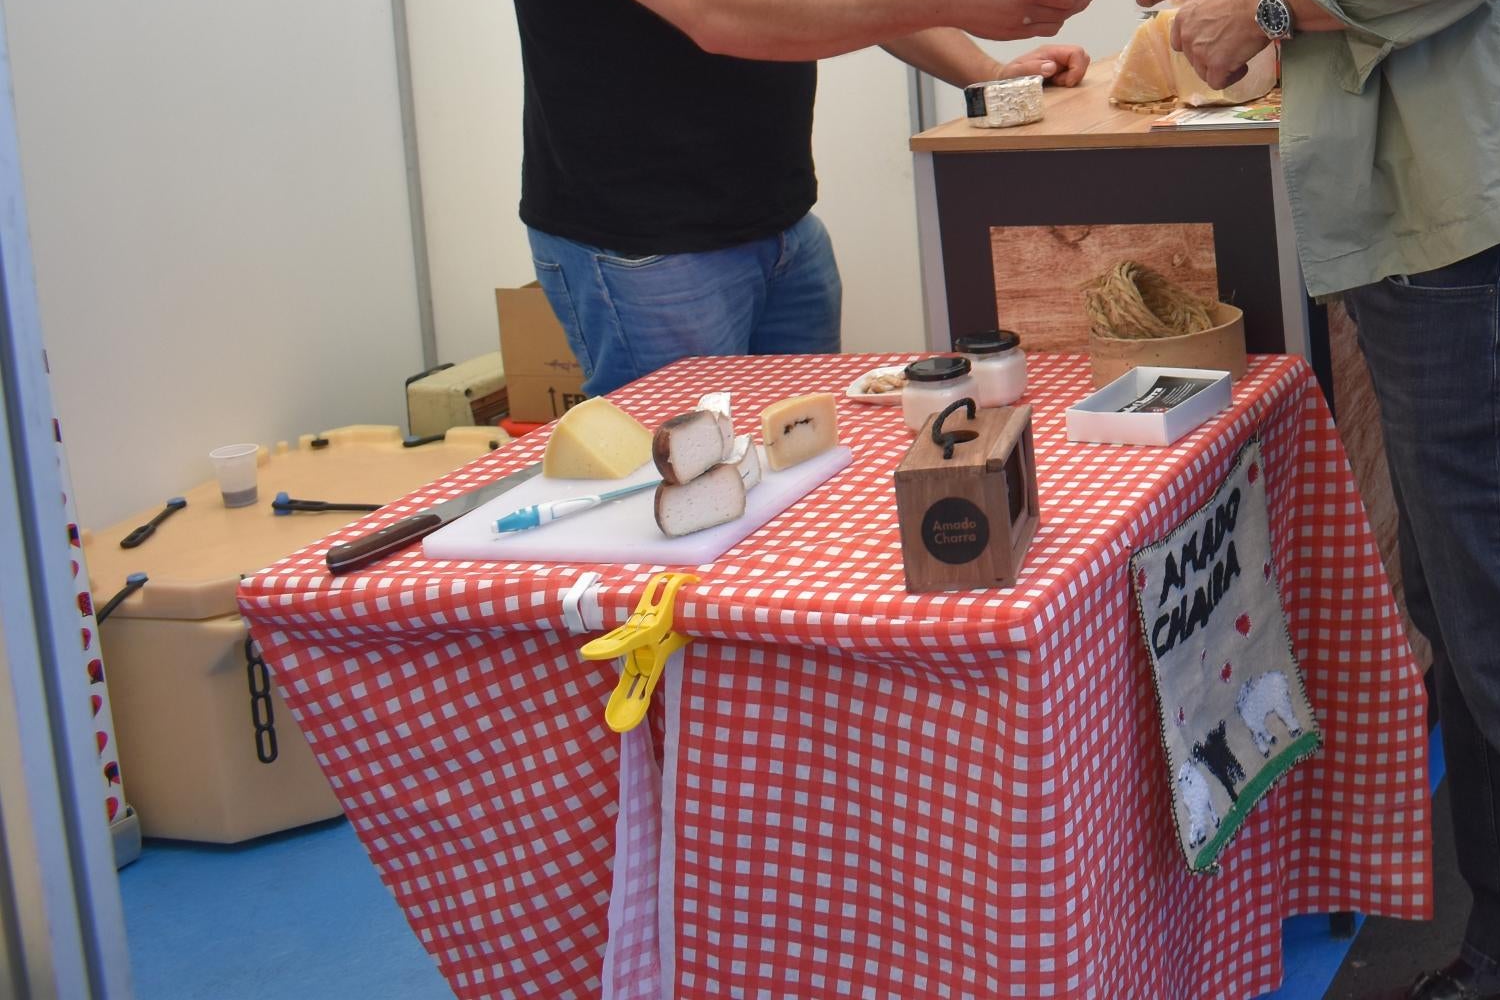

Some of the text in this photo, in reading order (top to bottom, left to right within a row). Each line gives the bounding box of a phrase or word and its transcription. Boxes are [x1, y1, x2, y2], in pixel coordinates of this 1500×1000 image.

[932, 516, 977, 532] Amado
[934, 531, 977, 545] Charra
[1158, 487, 1241, 609] AMADO
